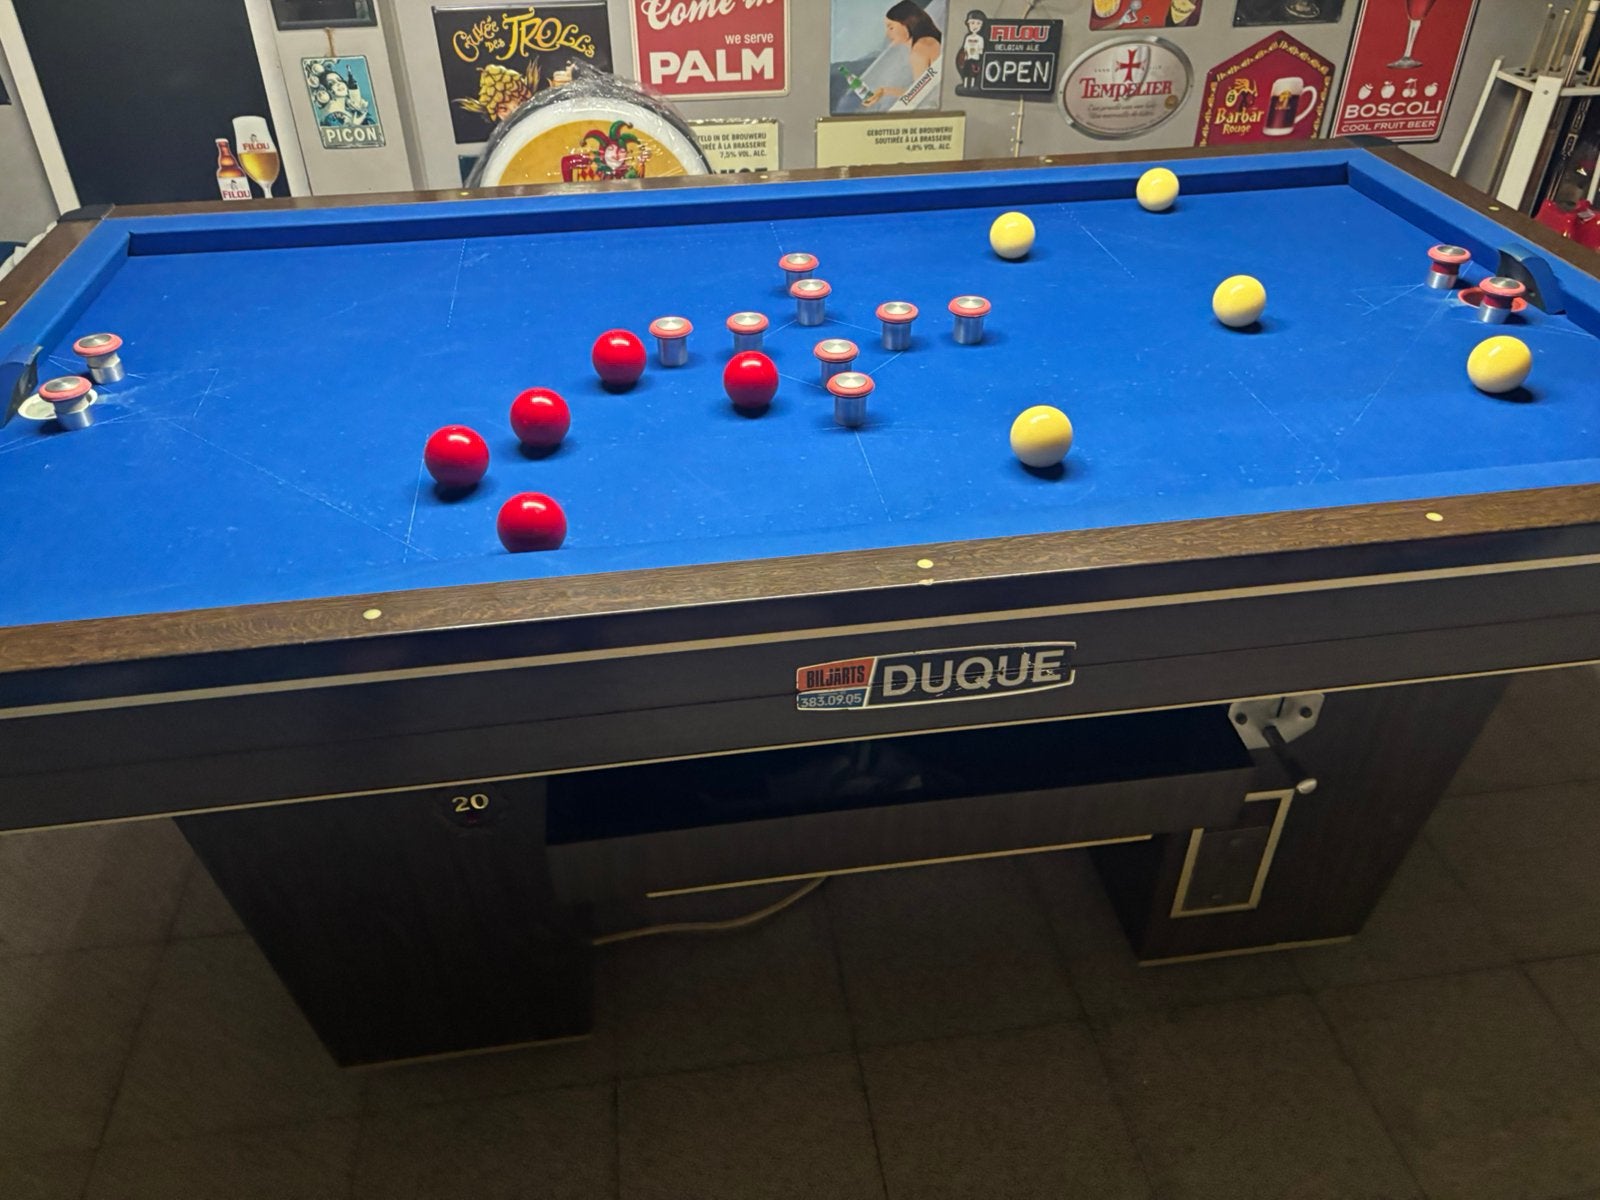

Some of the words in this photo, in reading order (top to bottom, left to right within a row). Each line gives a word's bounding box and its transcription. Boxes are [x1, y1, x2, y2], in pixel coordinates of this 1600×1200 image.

[641, 0, 736, 30] Come
[725, 34, 742, 44] we
[744, 32, 774, 44] serve
[990, 25, 1050, 42] FILOU
[994, 44, 1024, 52] BELGIAN
[1026, 43, 1040, 52] ALE
[649, 47, 774, 85] PALM
[985, 60, 1050, 84] OPEN
[1344, 99, 1443, 119] BOSCOLI
[867, 128, 900, 137] GEBOTTELD
[909, 127, 917, 135] DE
[1222, 123, 1252, 136] Rouge
[1341, 123, 1372, 133] COOL
[1373, 121, 1405, 130] FRUIT
[1407, 120, 1436, 129] BEER
[325, 127, 378, 143] PICON
[713, 134, 720, 142] IN
[721, 133, 730, 141] DE
[911, 135, 918, 143] LA
[919, 134, 952, 142] BRASSERIE
[242, 142, 270, 151] FILOU
[717, 141, 723, 149] À
[732, 140, 767, 149] BRASSERIE
[923, 143, 936, 151] VOL.
[720, 150, 737, 160] 7,5%
[738, 150, 752, 158] VOL.
[753, 149, 767, 157] ALC.
[222, 190, 251, 199] FILOU
[882, 648, 1065, 697] DUQUE
[800, 693, 862, 708] 383.09.05
[451, 793, 490, 813] 20
